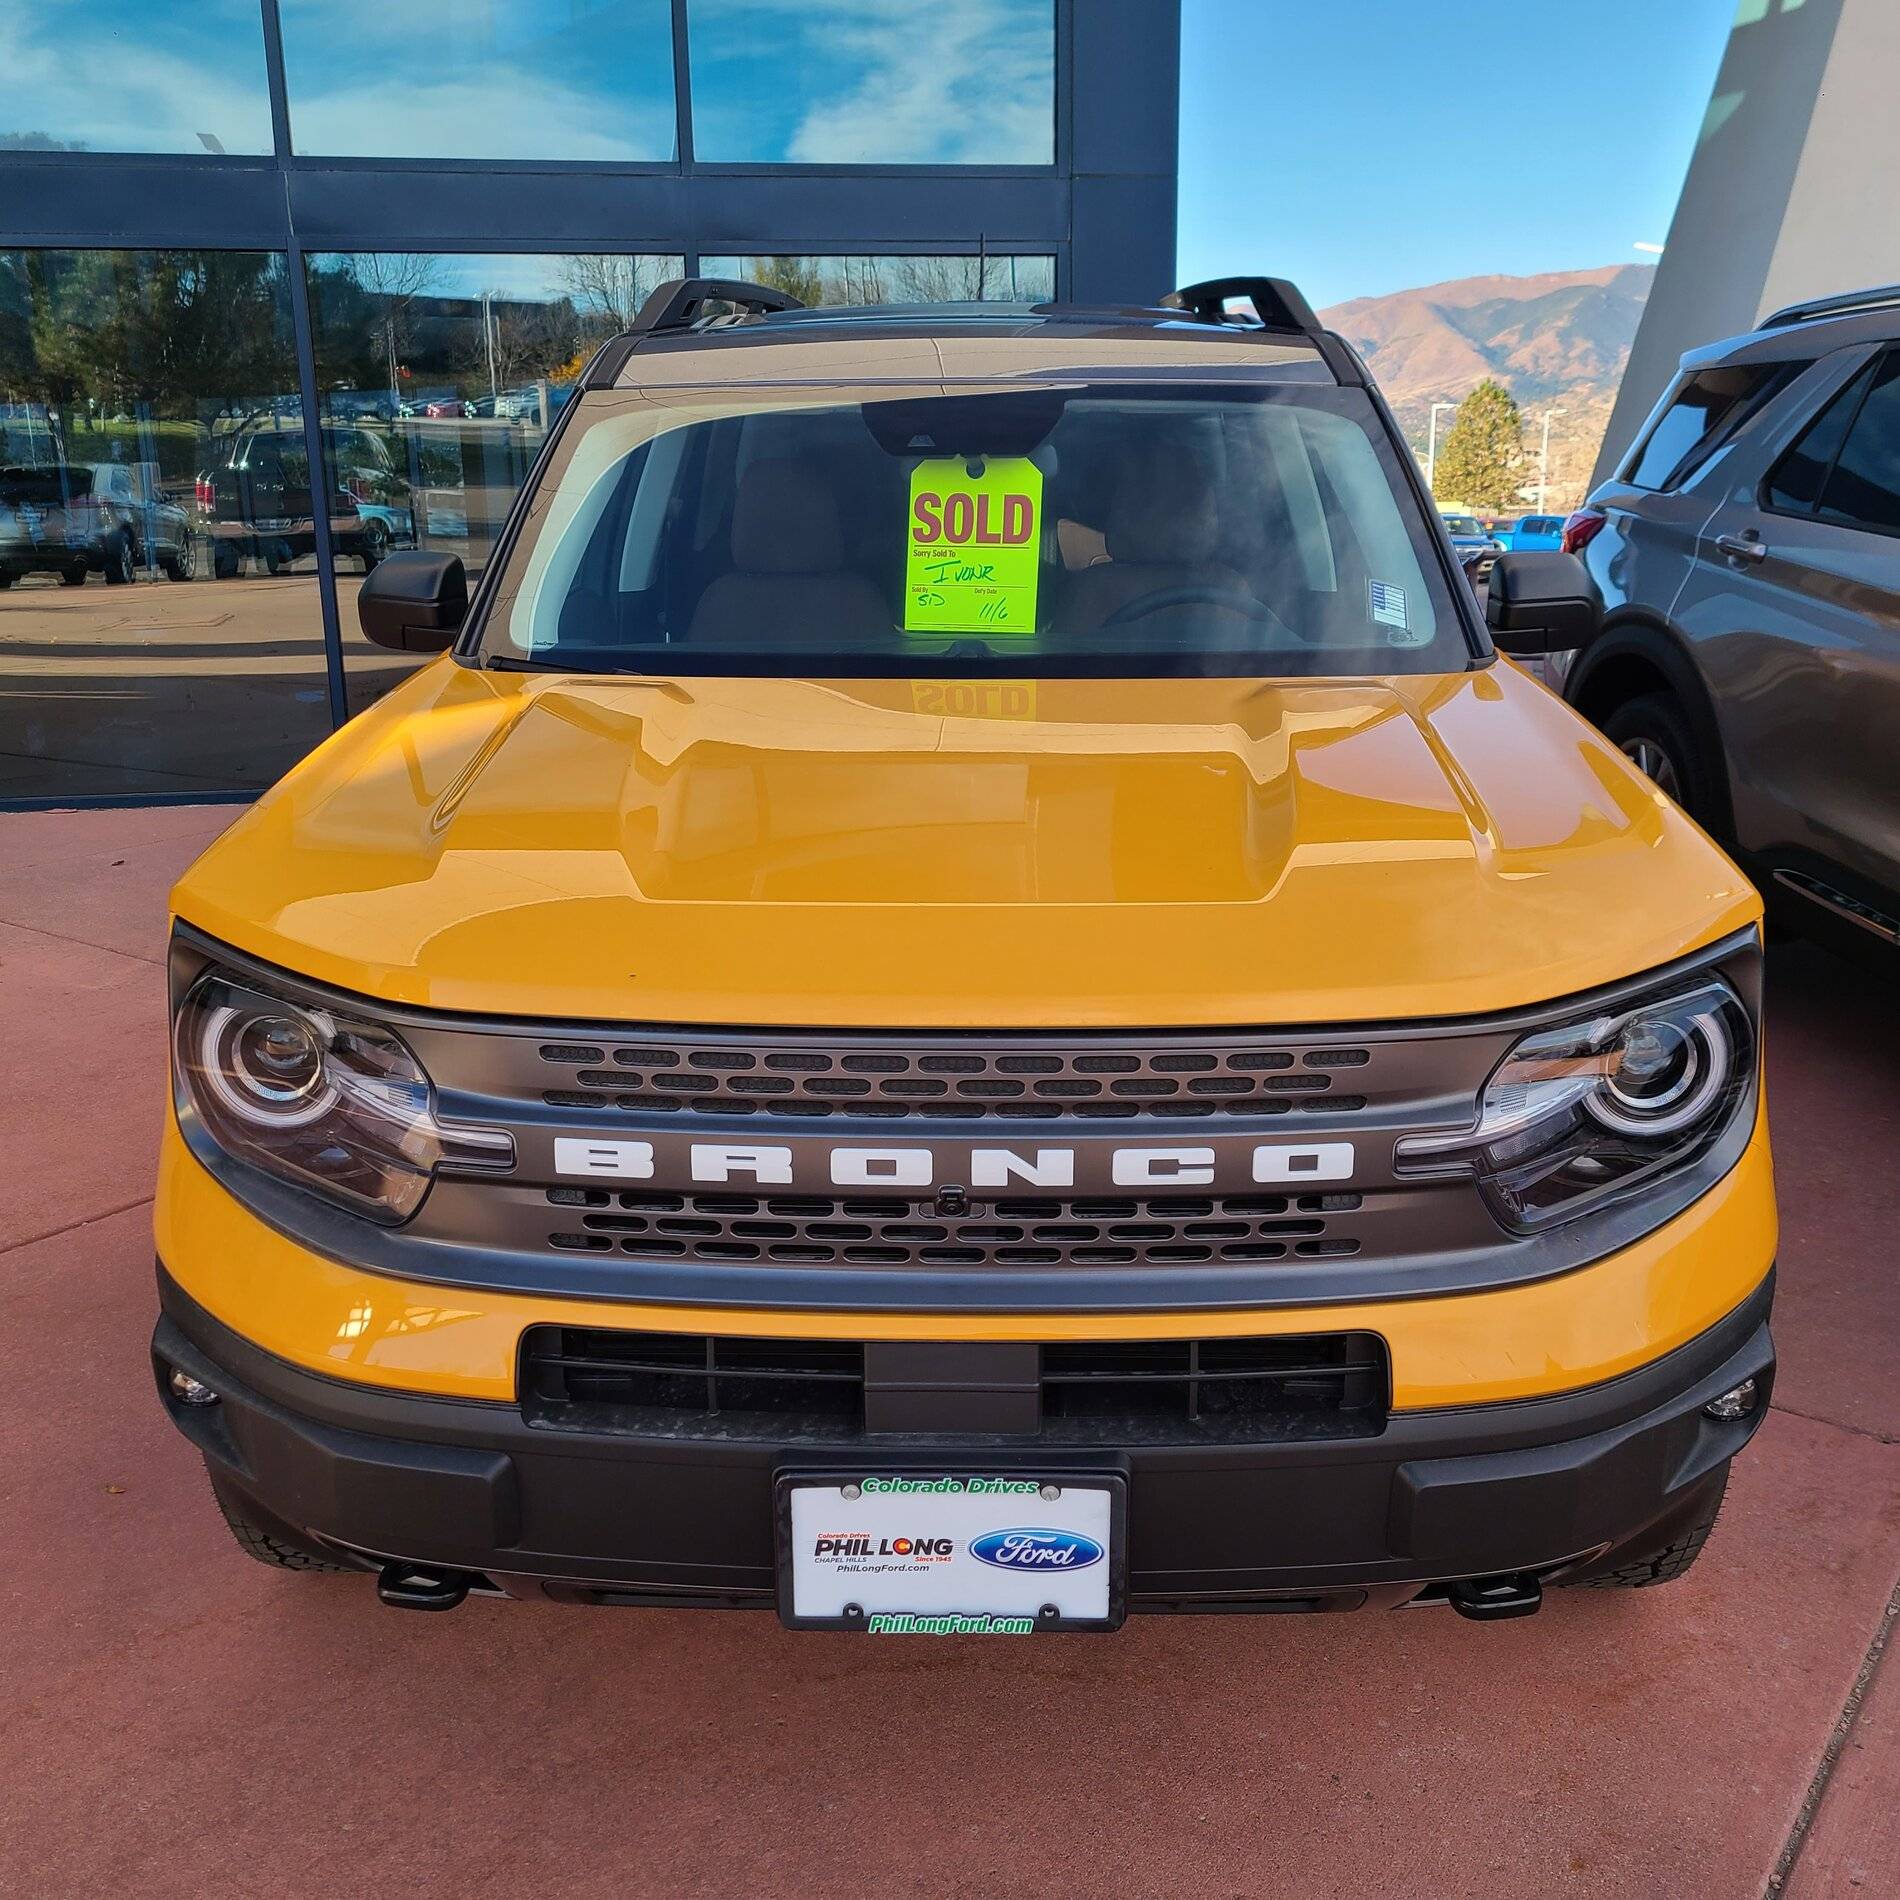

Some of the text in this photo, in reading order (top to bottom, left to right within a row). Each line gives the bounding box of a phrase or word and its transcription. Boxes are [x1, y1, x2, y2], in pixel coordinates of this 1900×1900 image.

[912, 492, 1034, 544] SOLD
[913, 549, 956, 558] Sorry Sold To
[979, 597, 1009, 622] 11/6
[554, 1137, 1354, 1187] BRONCO
[861, 1478, 1039, 1494] Colorado Drives
[814, 1537, 953, 1556] PHIL LONG
[996, 1535, 1075, 1565] Ford
[837, 1564, 930, 1573] PhilLongFord.com
[869, 1616, 1033, 1634] PhilLongFord.com
